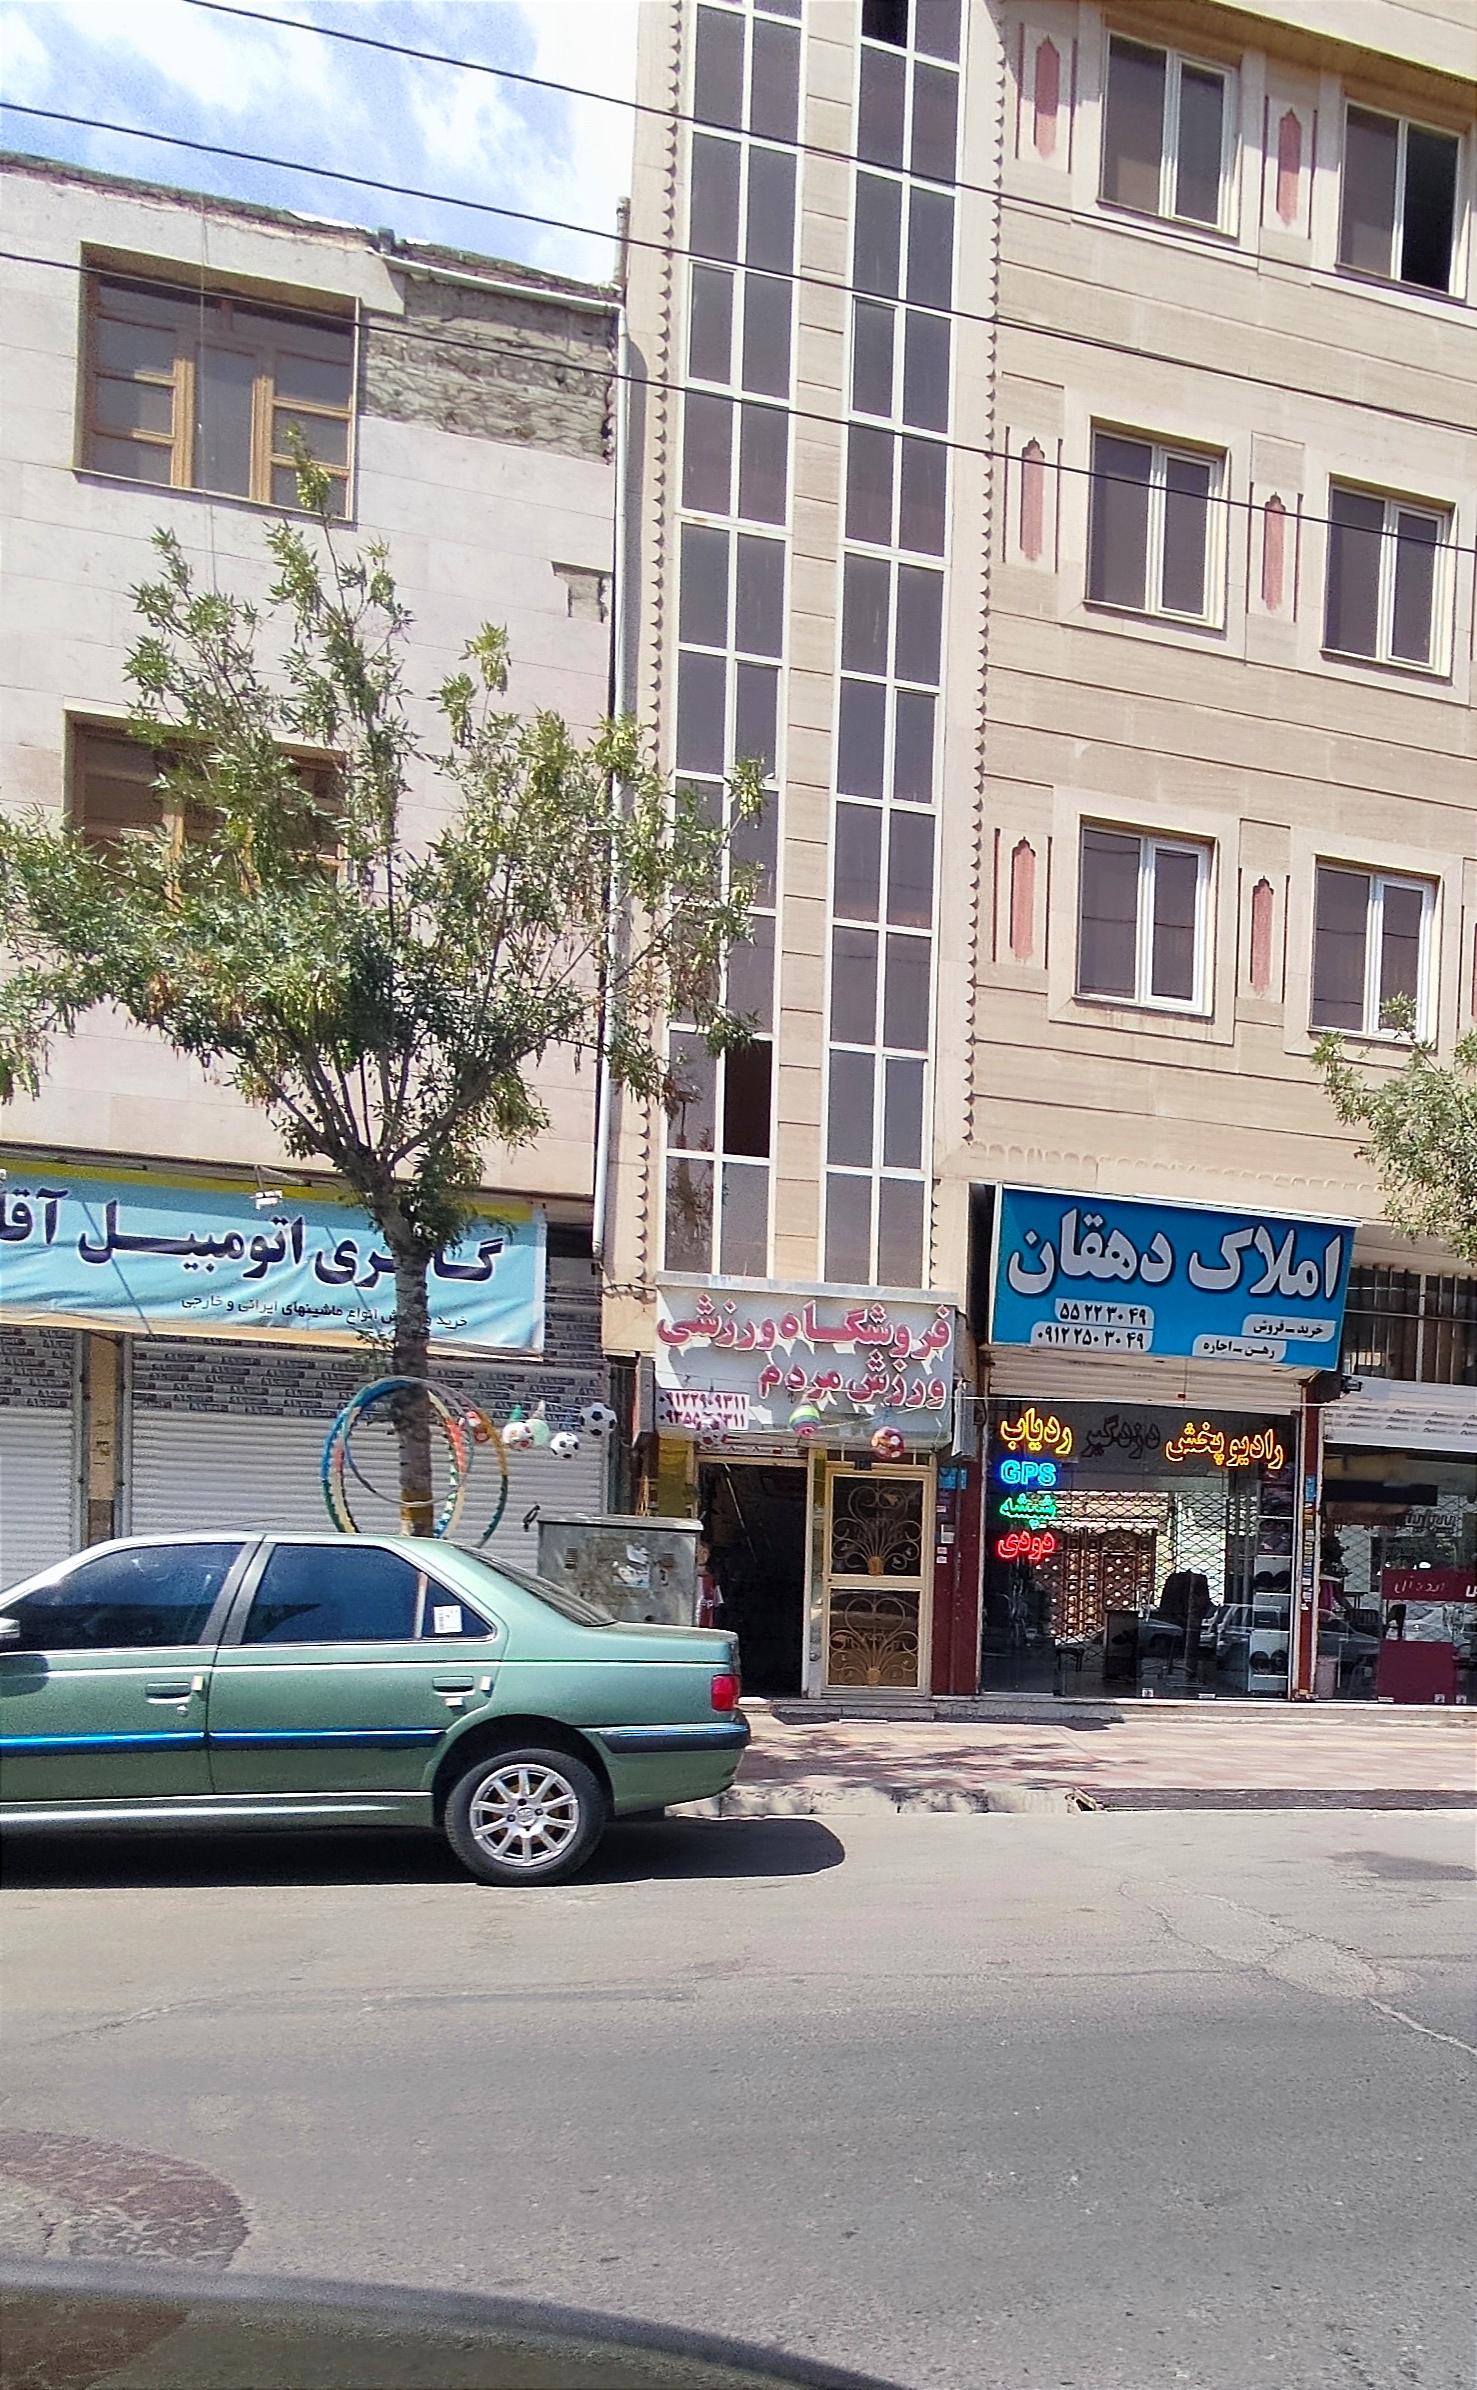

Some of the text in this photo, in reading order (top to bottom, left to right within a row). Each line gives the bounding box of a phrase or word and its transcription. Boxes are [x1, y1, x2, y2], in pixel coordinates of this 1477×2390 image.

[79, 1200, 304, 1278] اتومبیل
[1007, 1208, 1343, 1299] املاک دهقان
[181, 1295, 223, 1310] خارجی
[226, 1300, 235, 1311] و
[238, 1299, 278, 1313] ایرانی
[346, 1307, 377, 1325] انواع
[436, 1315, 467, 1329] خرید
[656, 1293, 951, 1360] فروشگاه ورزشی
[757, 1348, 946, 1411] ورزش مردم
[1000, 1407, 1073, 1455] ردیاب
[1226, 1428, 1284, 1470] رادیو
[1000, 1459, 1057, 1487] GPS
[999, 1492, 1057, 1530] شیشه
[997, 1530, 1056, 1560] دودی
